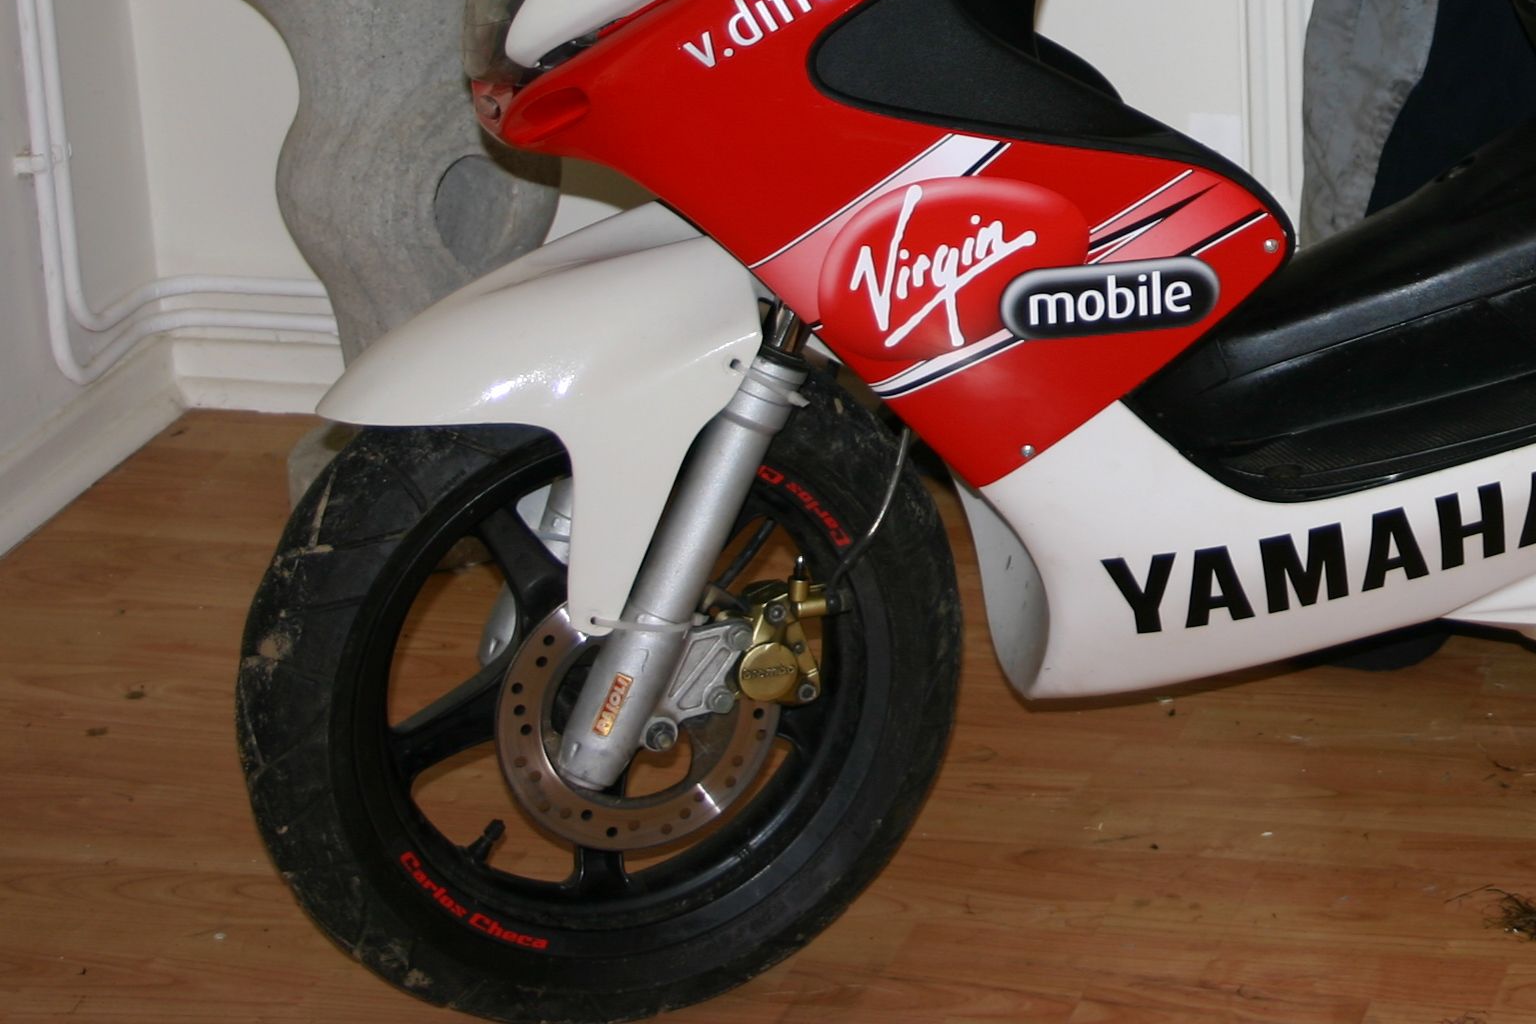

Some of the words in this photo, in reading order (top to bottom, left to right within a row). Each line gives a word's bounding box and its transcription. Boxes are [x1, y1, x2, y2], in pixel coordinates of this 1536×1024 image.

[850, 184, 1037, 347] Virgin
[1028, 270, 1193, 327] mobile
[784, 482, 852, 547] Carlos
[400, 851, 468, 917] Carlos
[468, 913, 549, 950] Checa
